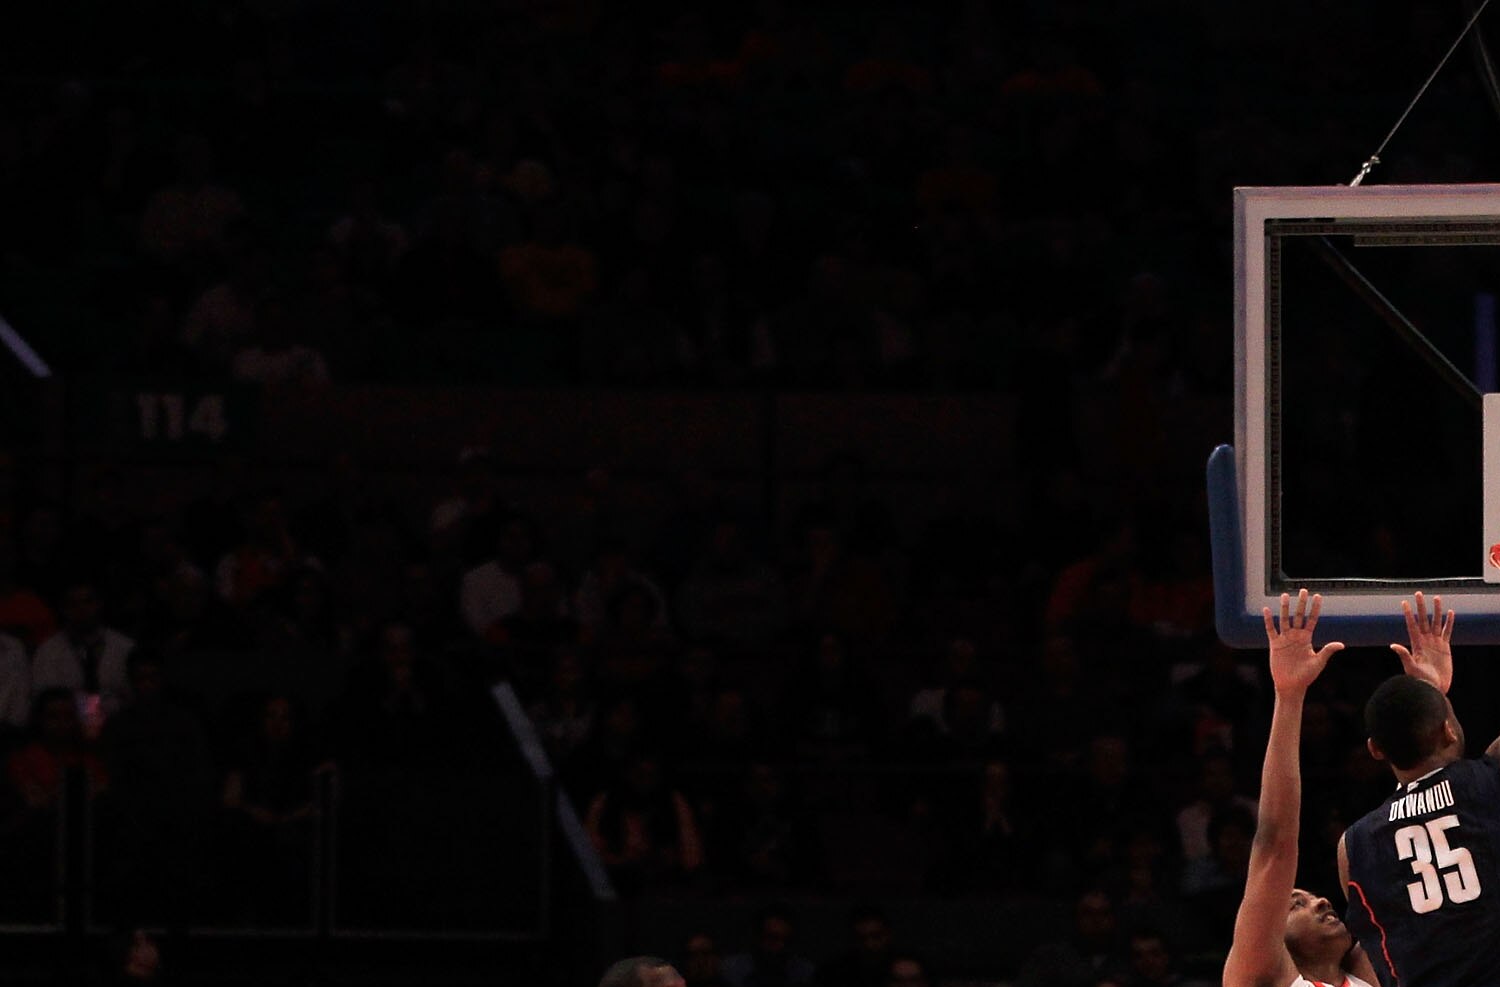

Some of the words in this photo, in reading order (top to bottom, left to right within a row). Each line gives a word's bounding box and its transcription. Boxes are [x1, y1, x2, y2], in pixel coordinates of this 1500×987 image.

[136, 392, 226, 442] 114
[1389, 779, 1455, 822] OKWANDU
[1394, 813, 1482, 915] 35
